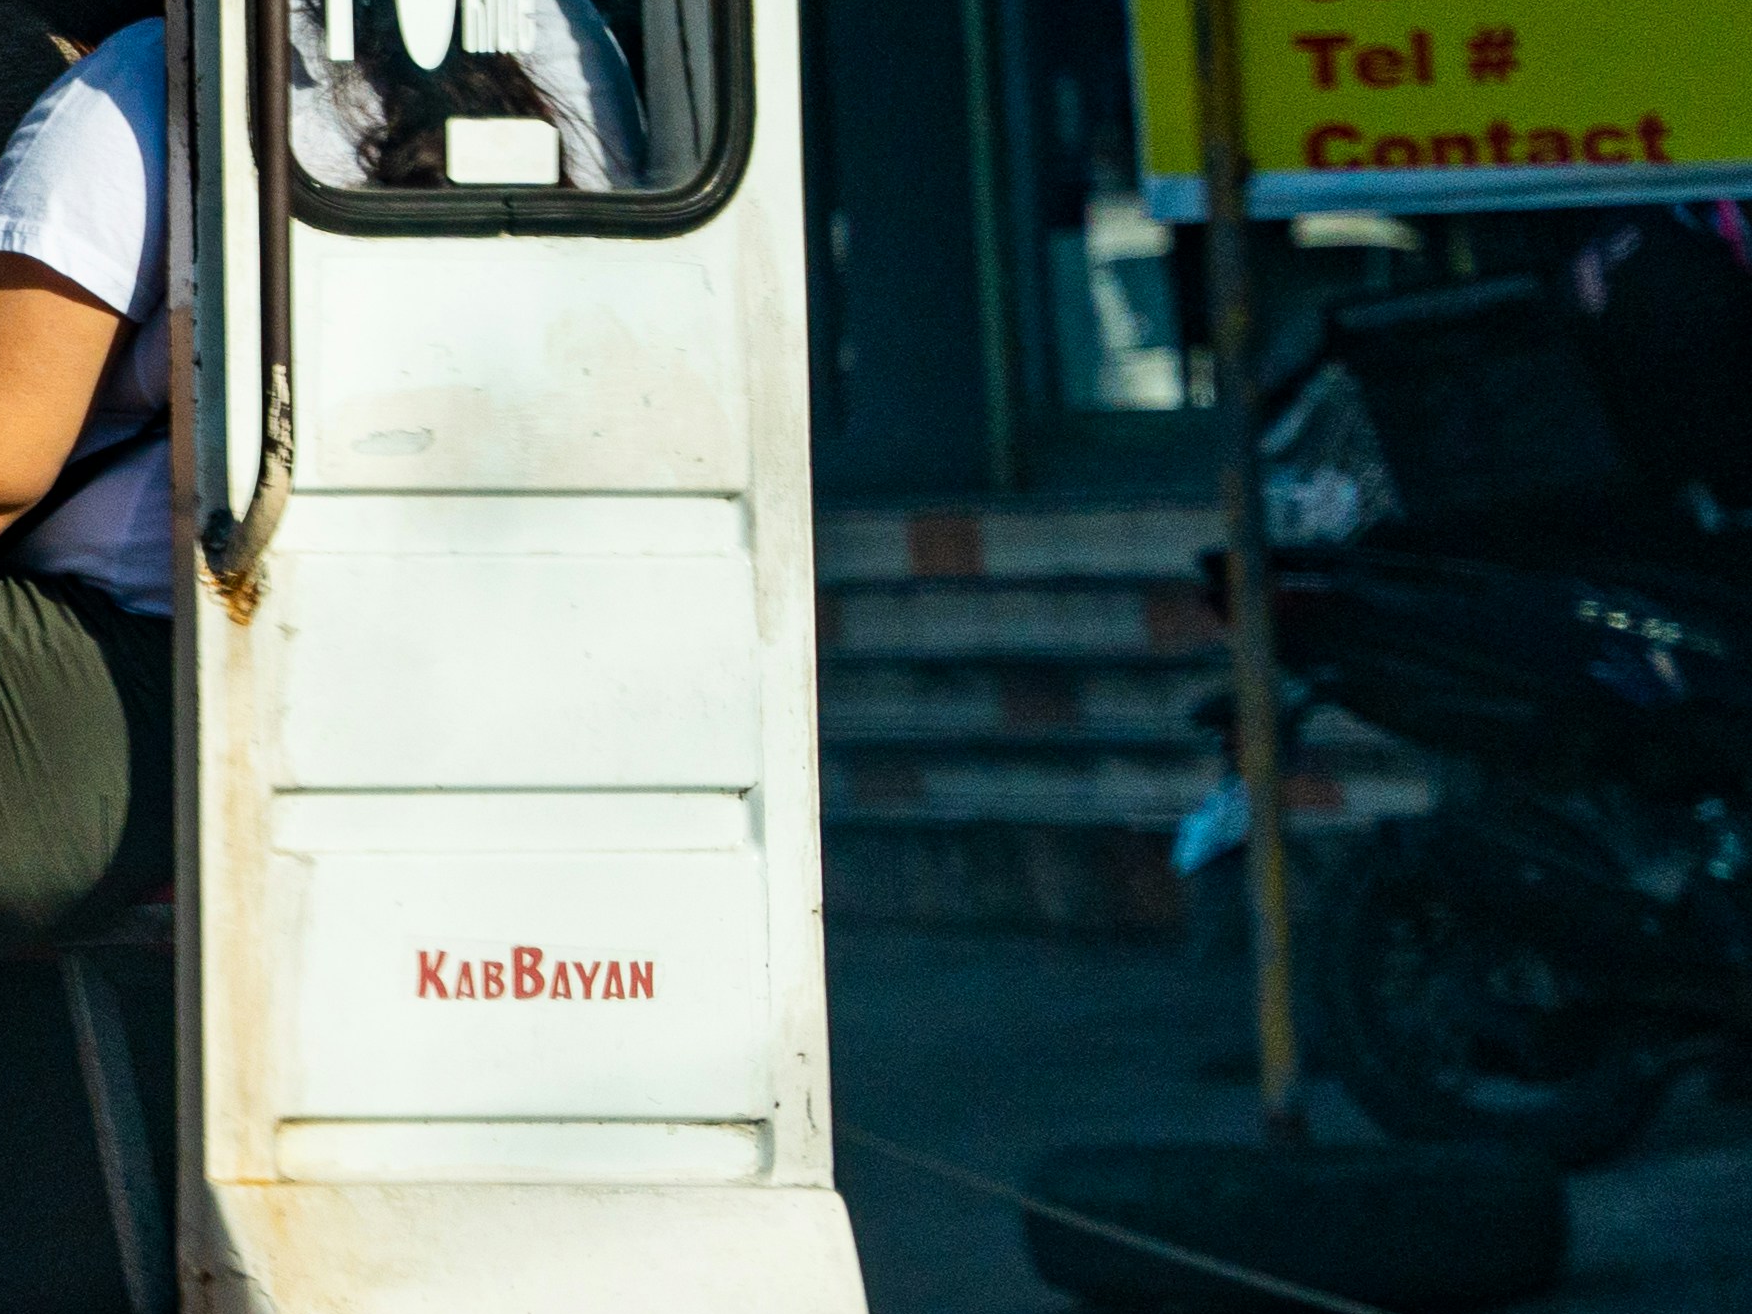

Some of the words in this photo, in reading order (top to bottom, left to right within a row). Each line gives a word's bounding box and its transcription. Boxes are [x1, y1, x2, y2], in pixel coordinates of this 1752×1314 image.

[1291, 26, 1435, 91] Tel
[1466, 24, 1521, 83] #
[1304, 111, 1676, 170] Contact
